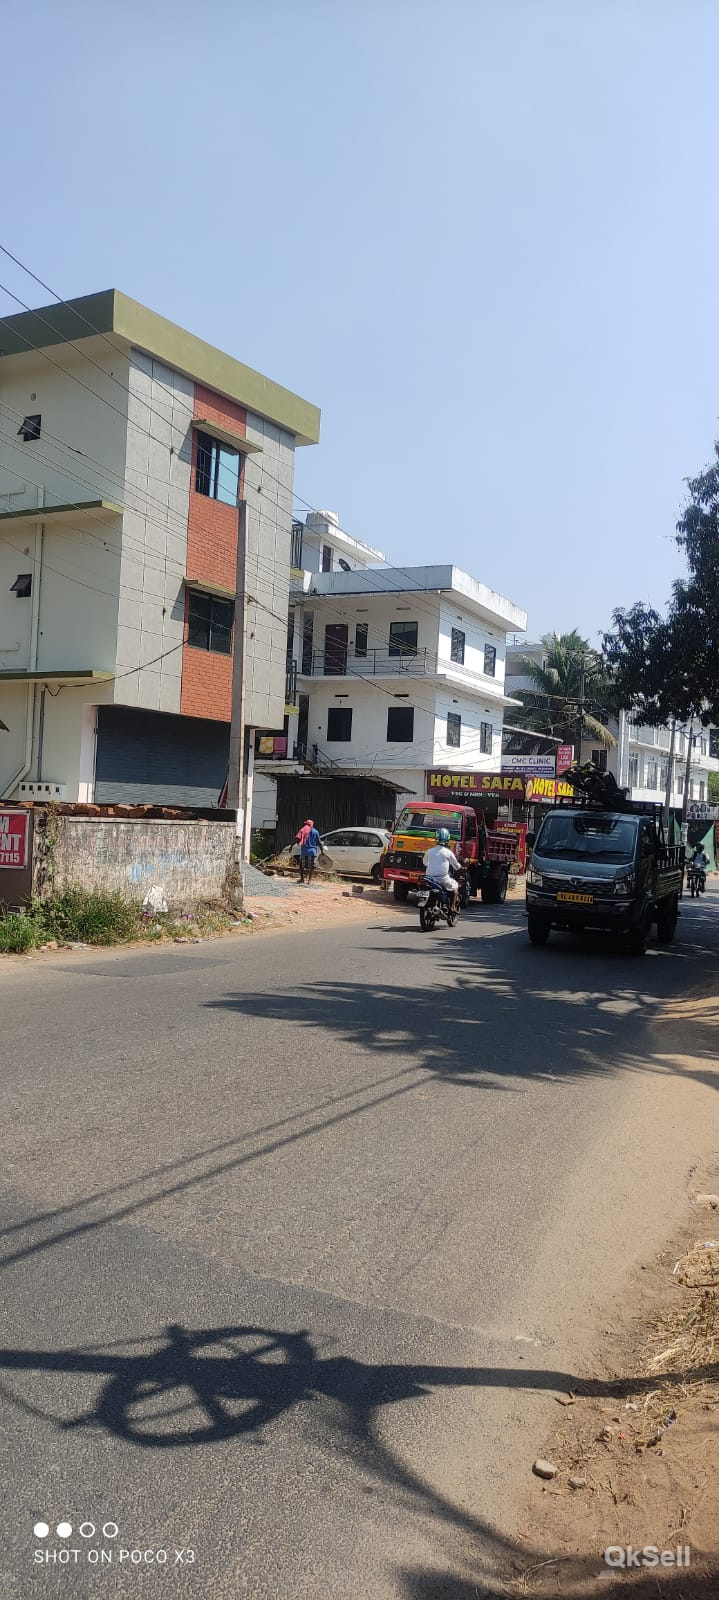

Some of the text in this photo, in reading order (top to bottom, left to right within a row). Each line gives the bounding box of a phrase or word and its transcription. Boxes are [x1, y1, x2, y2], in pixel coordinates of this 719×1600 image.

[511, 757, 551, 765] CMC CLINIC
[430, 774, 523, 790] HOTEL SAFA
[532, 777, 556, 797] HOTEL
[0, 833, 22, 851] NT
[0, 852, 20, 863] 7115
